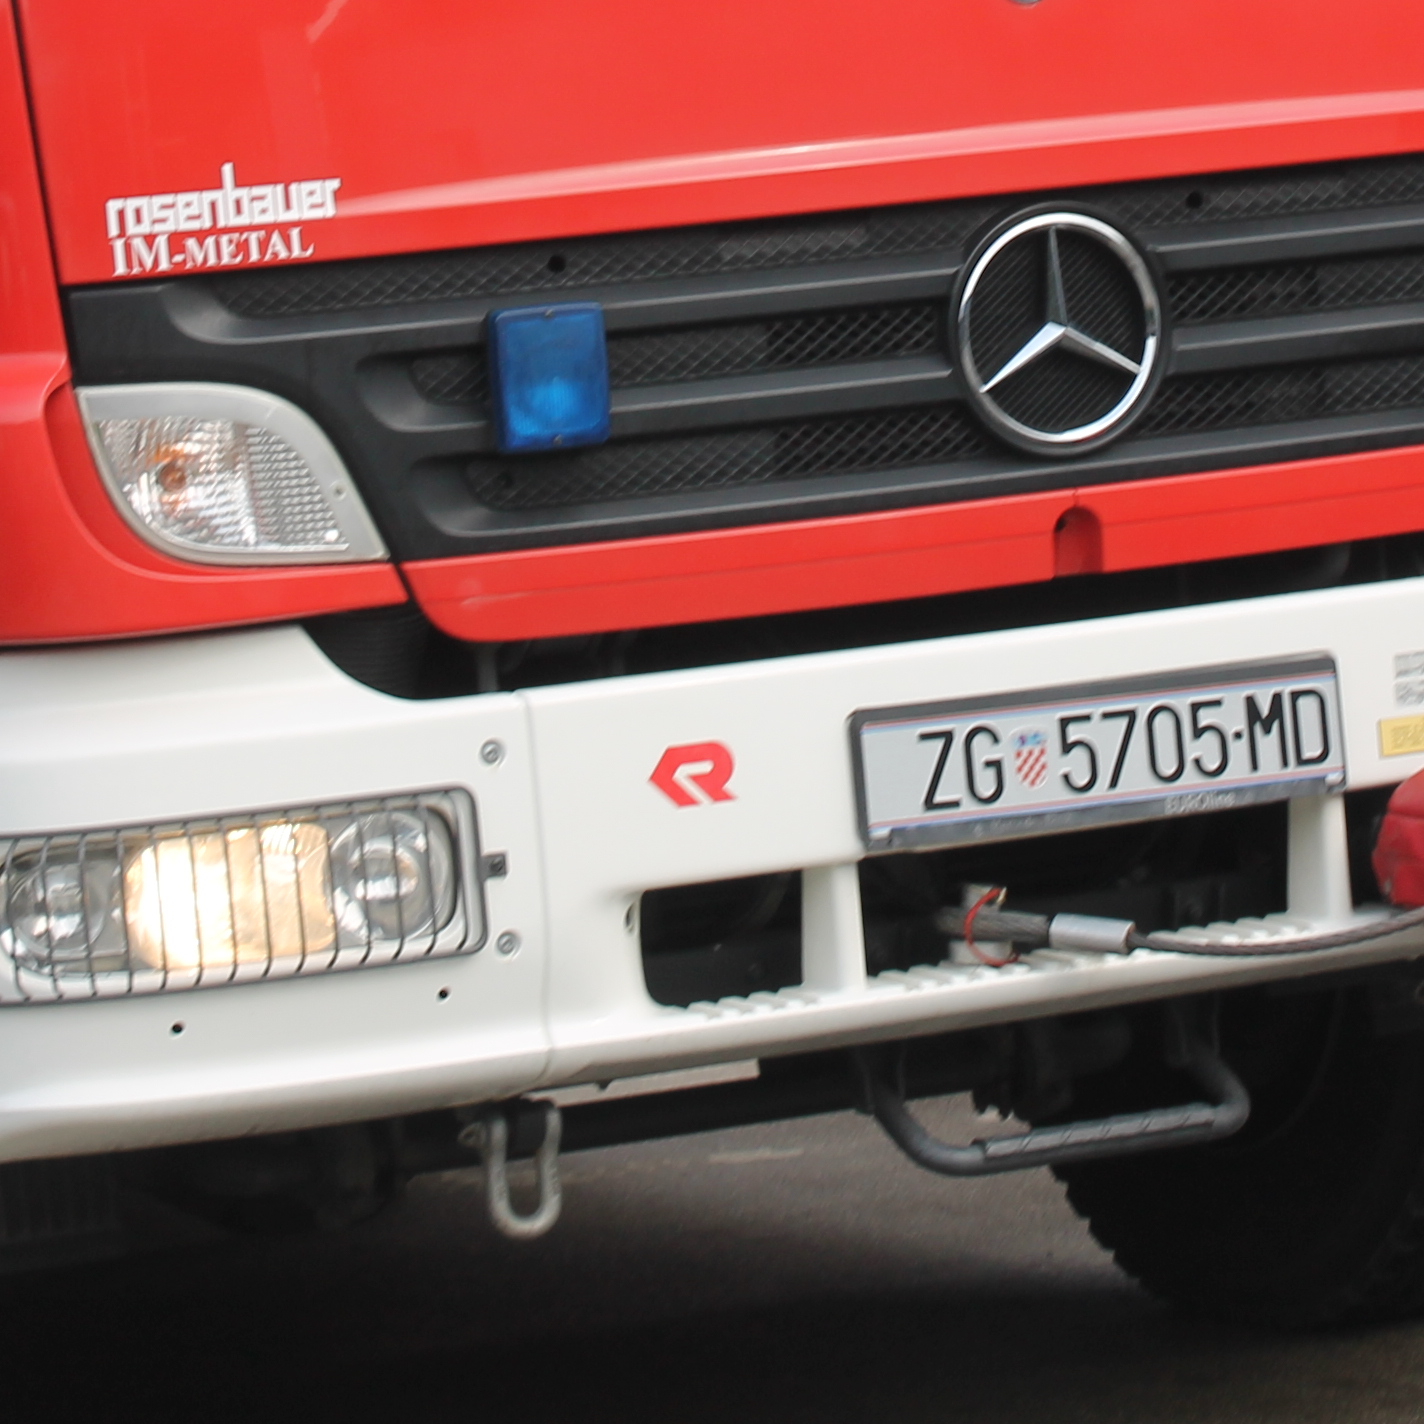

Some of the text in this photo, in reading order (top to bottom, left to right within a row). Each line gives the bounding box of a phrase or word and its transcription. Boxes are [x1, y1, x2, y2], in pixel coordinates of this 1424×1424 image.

[105, 162, 342, 239] rosenbauer
[108, 226, 315, 277] IM-METAL
[918, 725, 1005, 811] ZG
